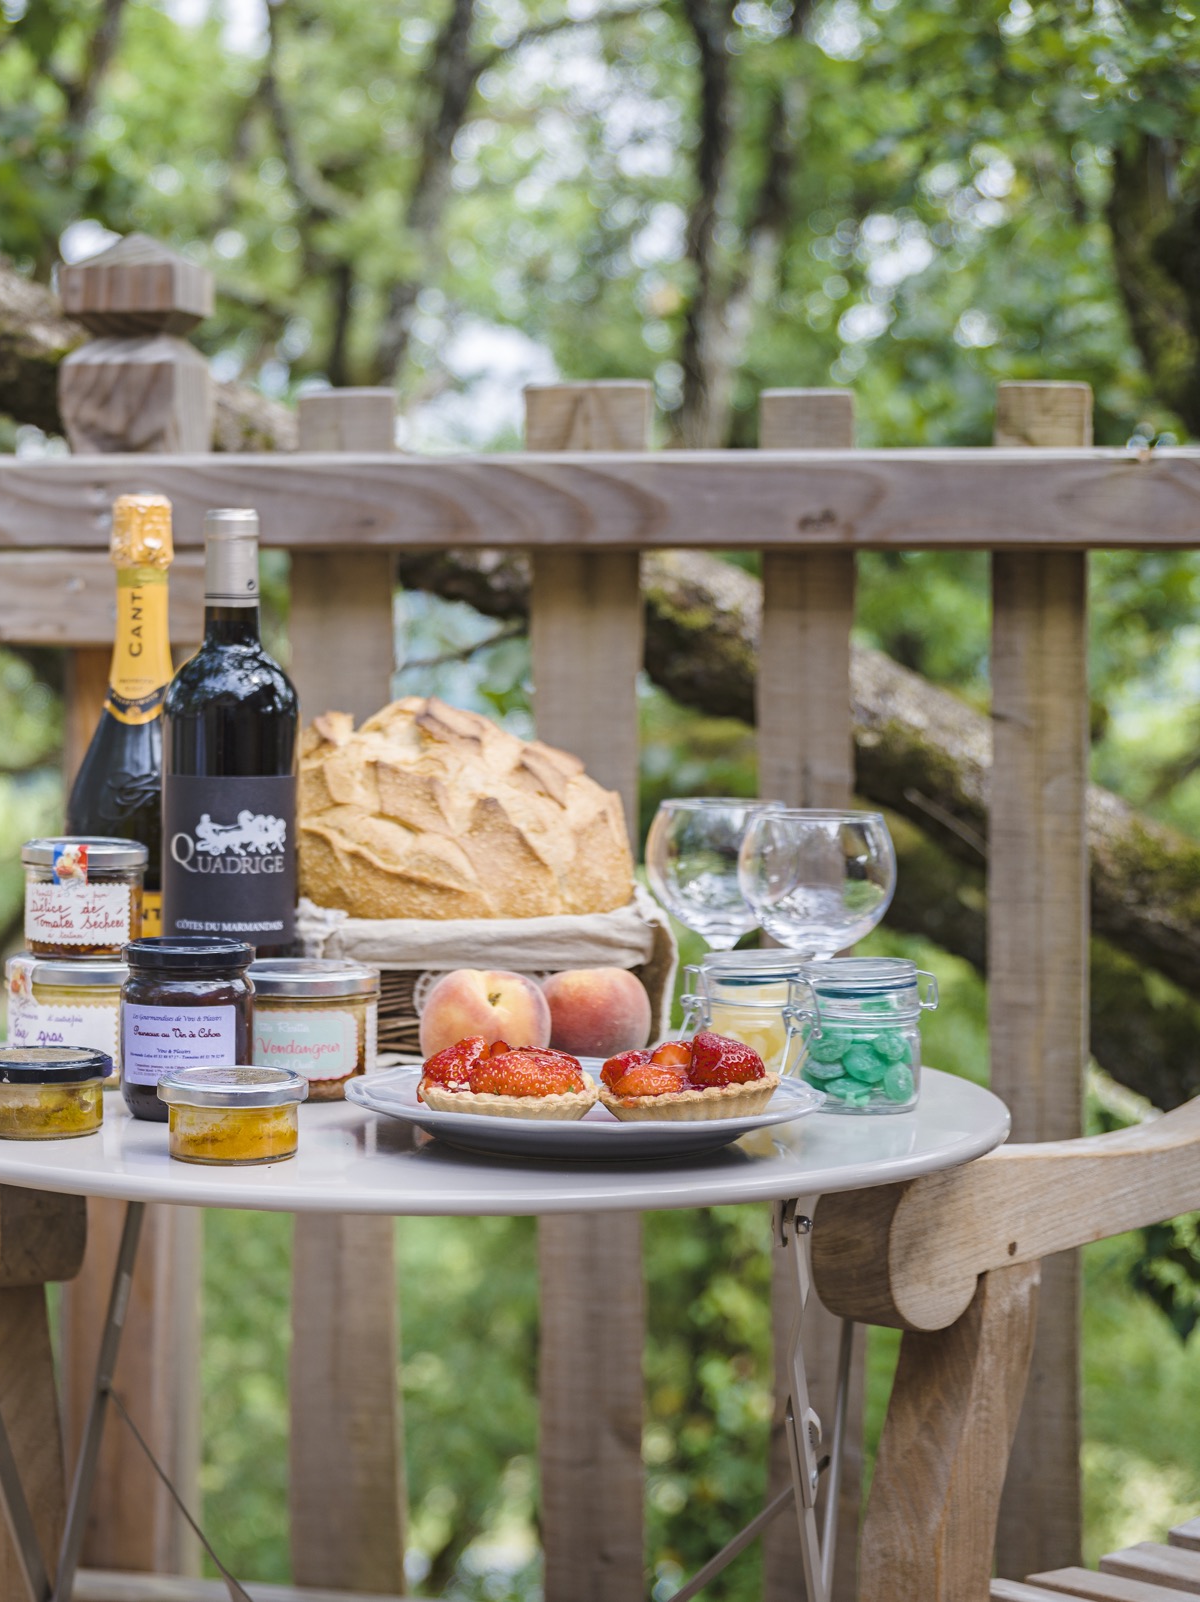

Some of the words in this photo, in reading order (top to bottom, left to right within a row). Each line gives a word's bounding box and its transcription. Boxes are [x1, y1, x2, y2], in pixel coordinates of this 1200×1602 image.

[171, 832, 285, 874] QUADRIGE
[30, 898, 71, 913] Délice
[80, 901, 105, 914] de
[176, 919, 203, 931] CÔTES
[204, 921, 220, 932] DU
[36, 1030, 64, 1047] gras
[172, 1028, 187, 1038] Vin
[188, 1030, 196, 1038] de
[257, 1038, 340, 1059] Vendangeur
